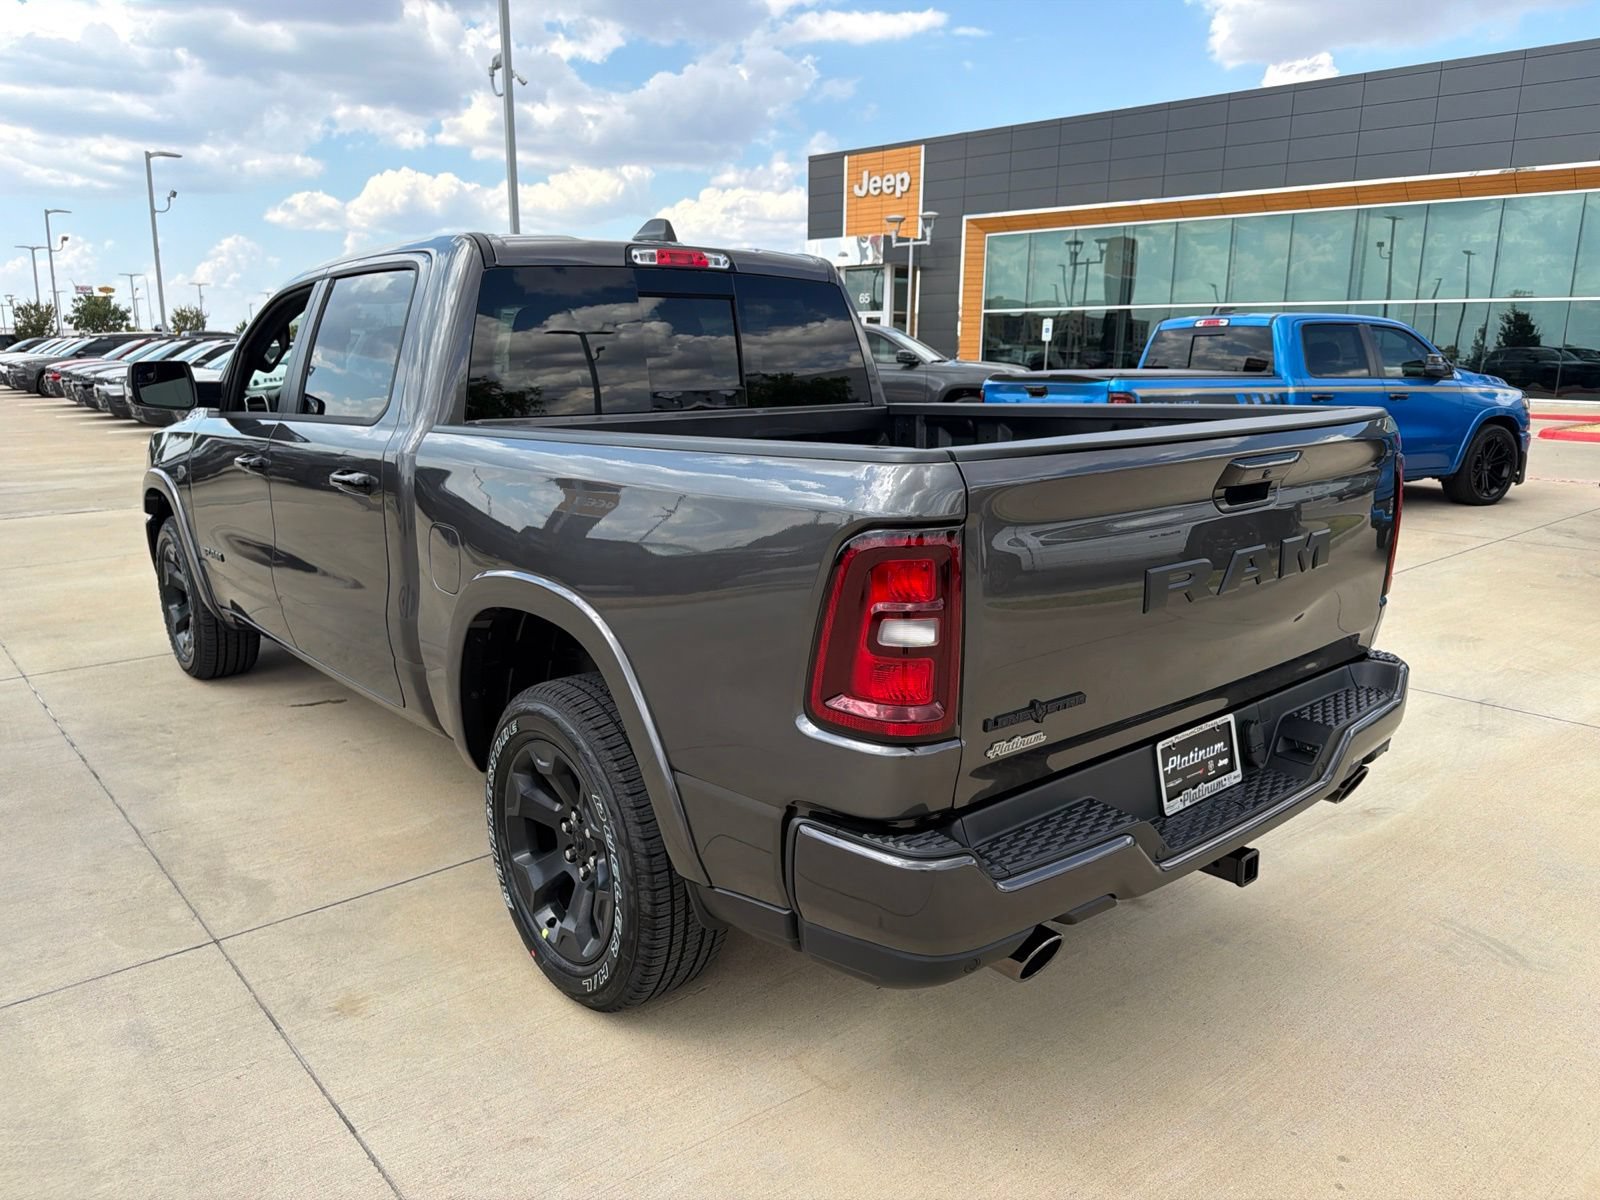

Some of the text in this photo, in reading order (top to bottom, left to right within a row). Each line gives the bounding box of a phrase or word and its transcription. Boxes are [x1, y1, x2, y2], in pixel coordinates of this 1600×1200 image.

[853, 169, 911, 198] Jeep
[858, 292, 871, 304] 65
[1142, 528, 1332, 615] RAM
[985, 730, 1047, 760] Platinum
[1163, 741, 1228, 775] Platinum
[1182, 778, 1227, 807] Platinum
[582, 793, 622, 993] DUELER H/L
